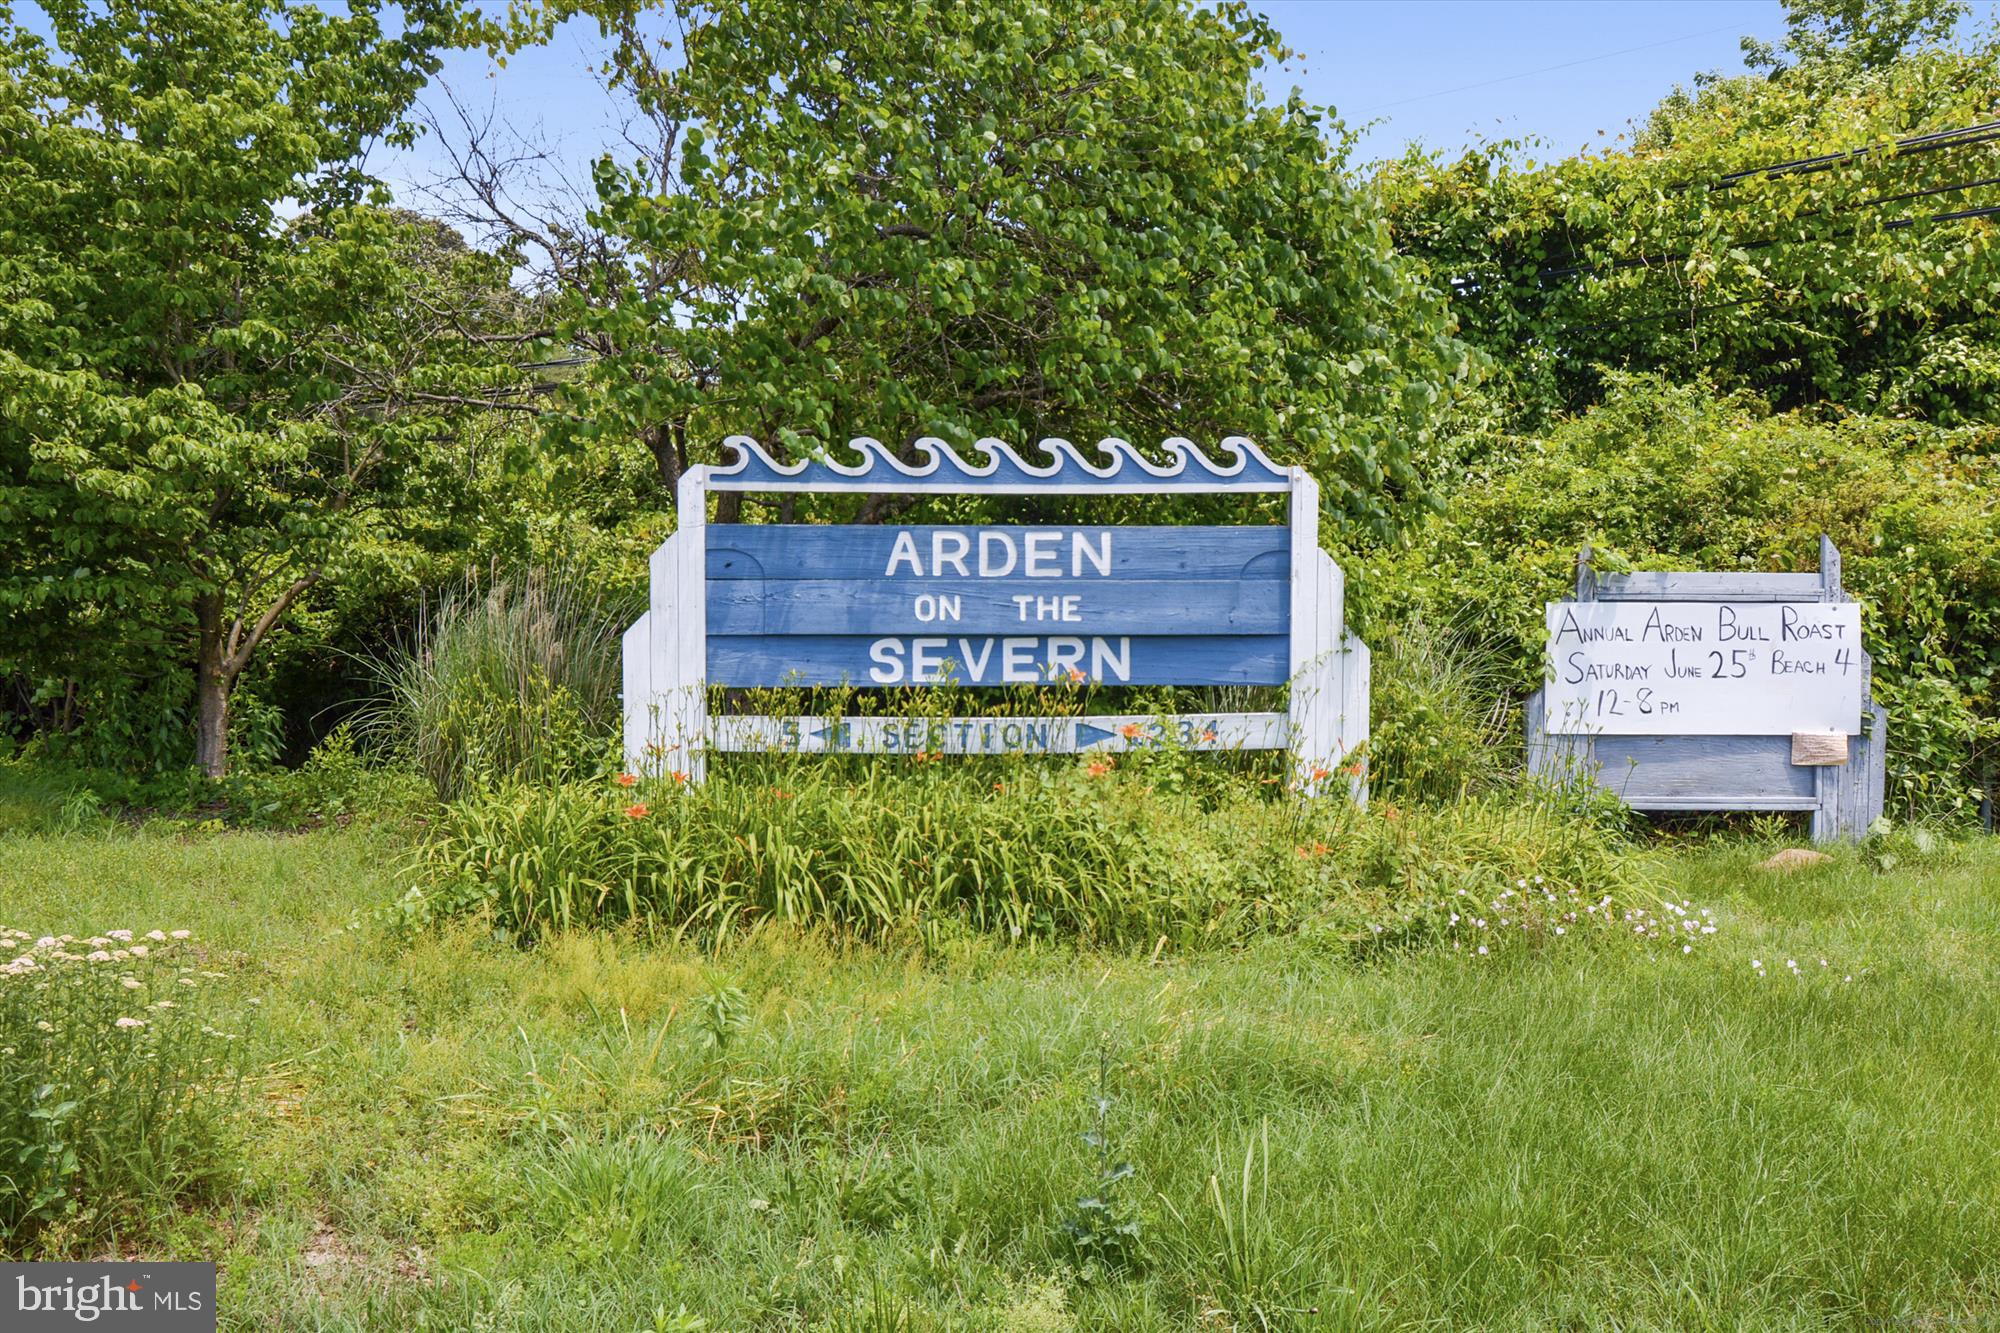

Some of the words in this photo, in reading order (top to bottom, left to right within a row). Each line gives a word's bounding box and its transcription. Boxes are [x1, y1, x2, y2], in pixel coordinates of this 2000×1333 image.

[884, 530, 1112, 578] ARDEN
[914, 594, 962, 622] ON
[1012, 594, 1083, 622] THE
[1555, 606, 1634, 645] ANNUAL
[1641, 606, 1703, 643] ARDEN
[1719, 605, 1770, 642] BULL
[1781, 605, 1847, 642] ROAST
[869, 636, 1131, 684] SEVERN
[1564, 651, 1653, 685] SATURDAY
[1664, 648, 1703, 679] JUNE
[1771, 649, 1826, 675] BEACH
[1834, 647, 1858, 677] 4
[1597, 687, 1653, 717] 12-8
[1660, 700, 1680, 714] PM
[881, 722, 1048, 749] SECTION
